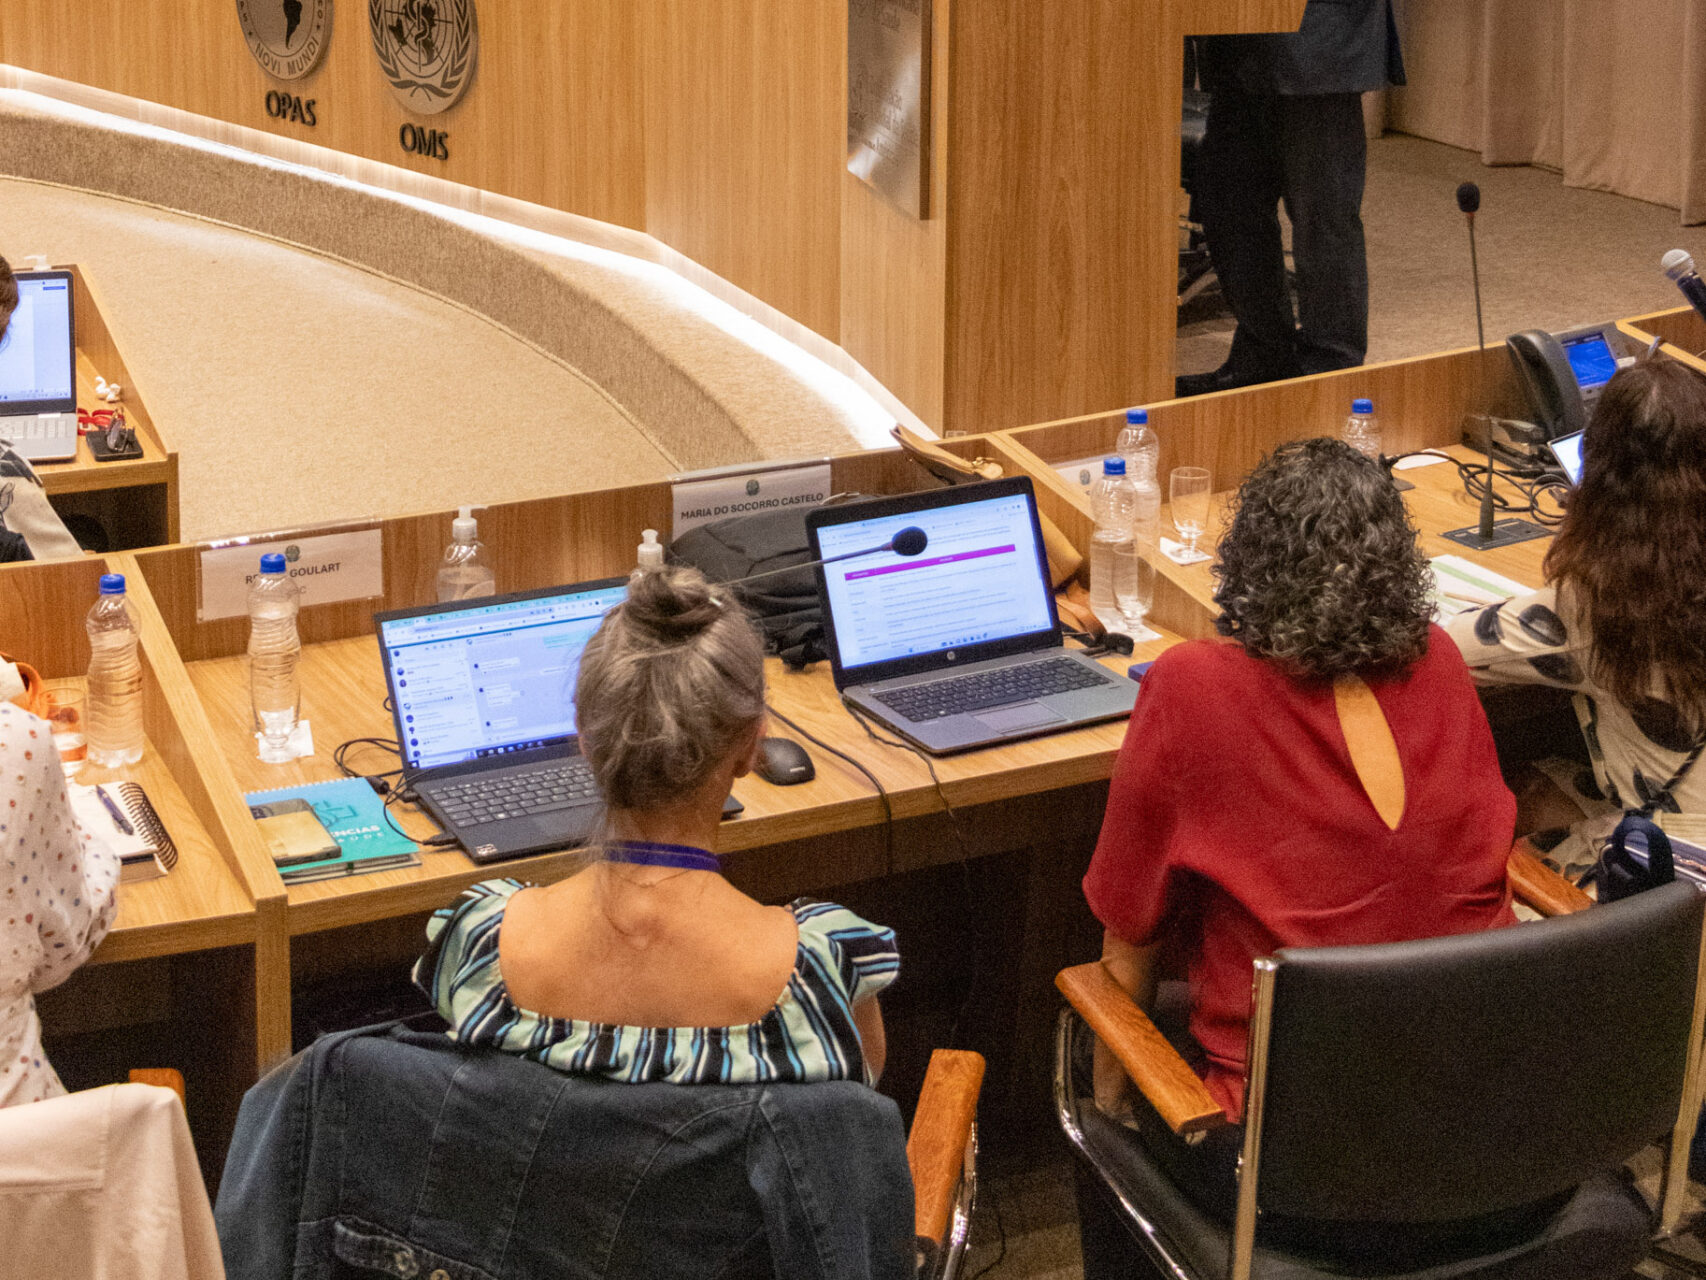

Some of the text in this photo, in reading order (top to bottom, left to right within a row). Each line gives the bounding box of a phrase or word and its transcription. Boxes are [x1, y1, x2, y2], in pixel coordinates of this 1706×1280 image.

[255, 36, 319, 76] NOVI MUNDI
[265, 89, 317, 127] OPAS
[399, 122, 449, 160] OMS
[680, 492, 824, 521] MARIA DO SOCORRO CASTELO
[289, 562, 341, 578] GOULART
